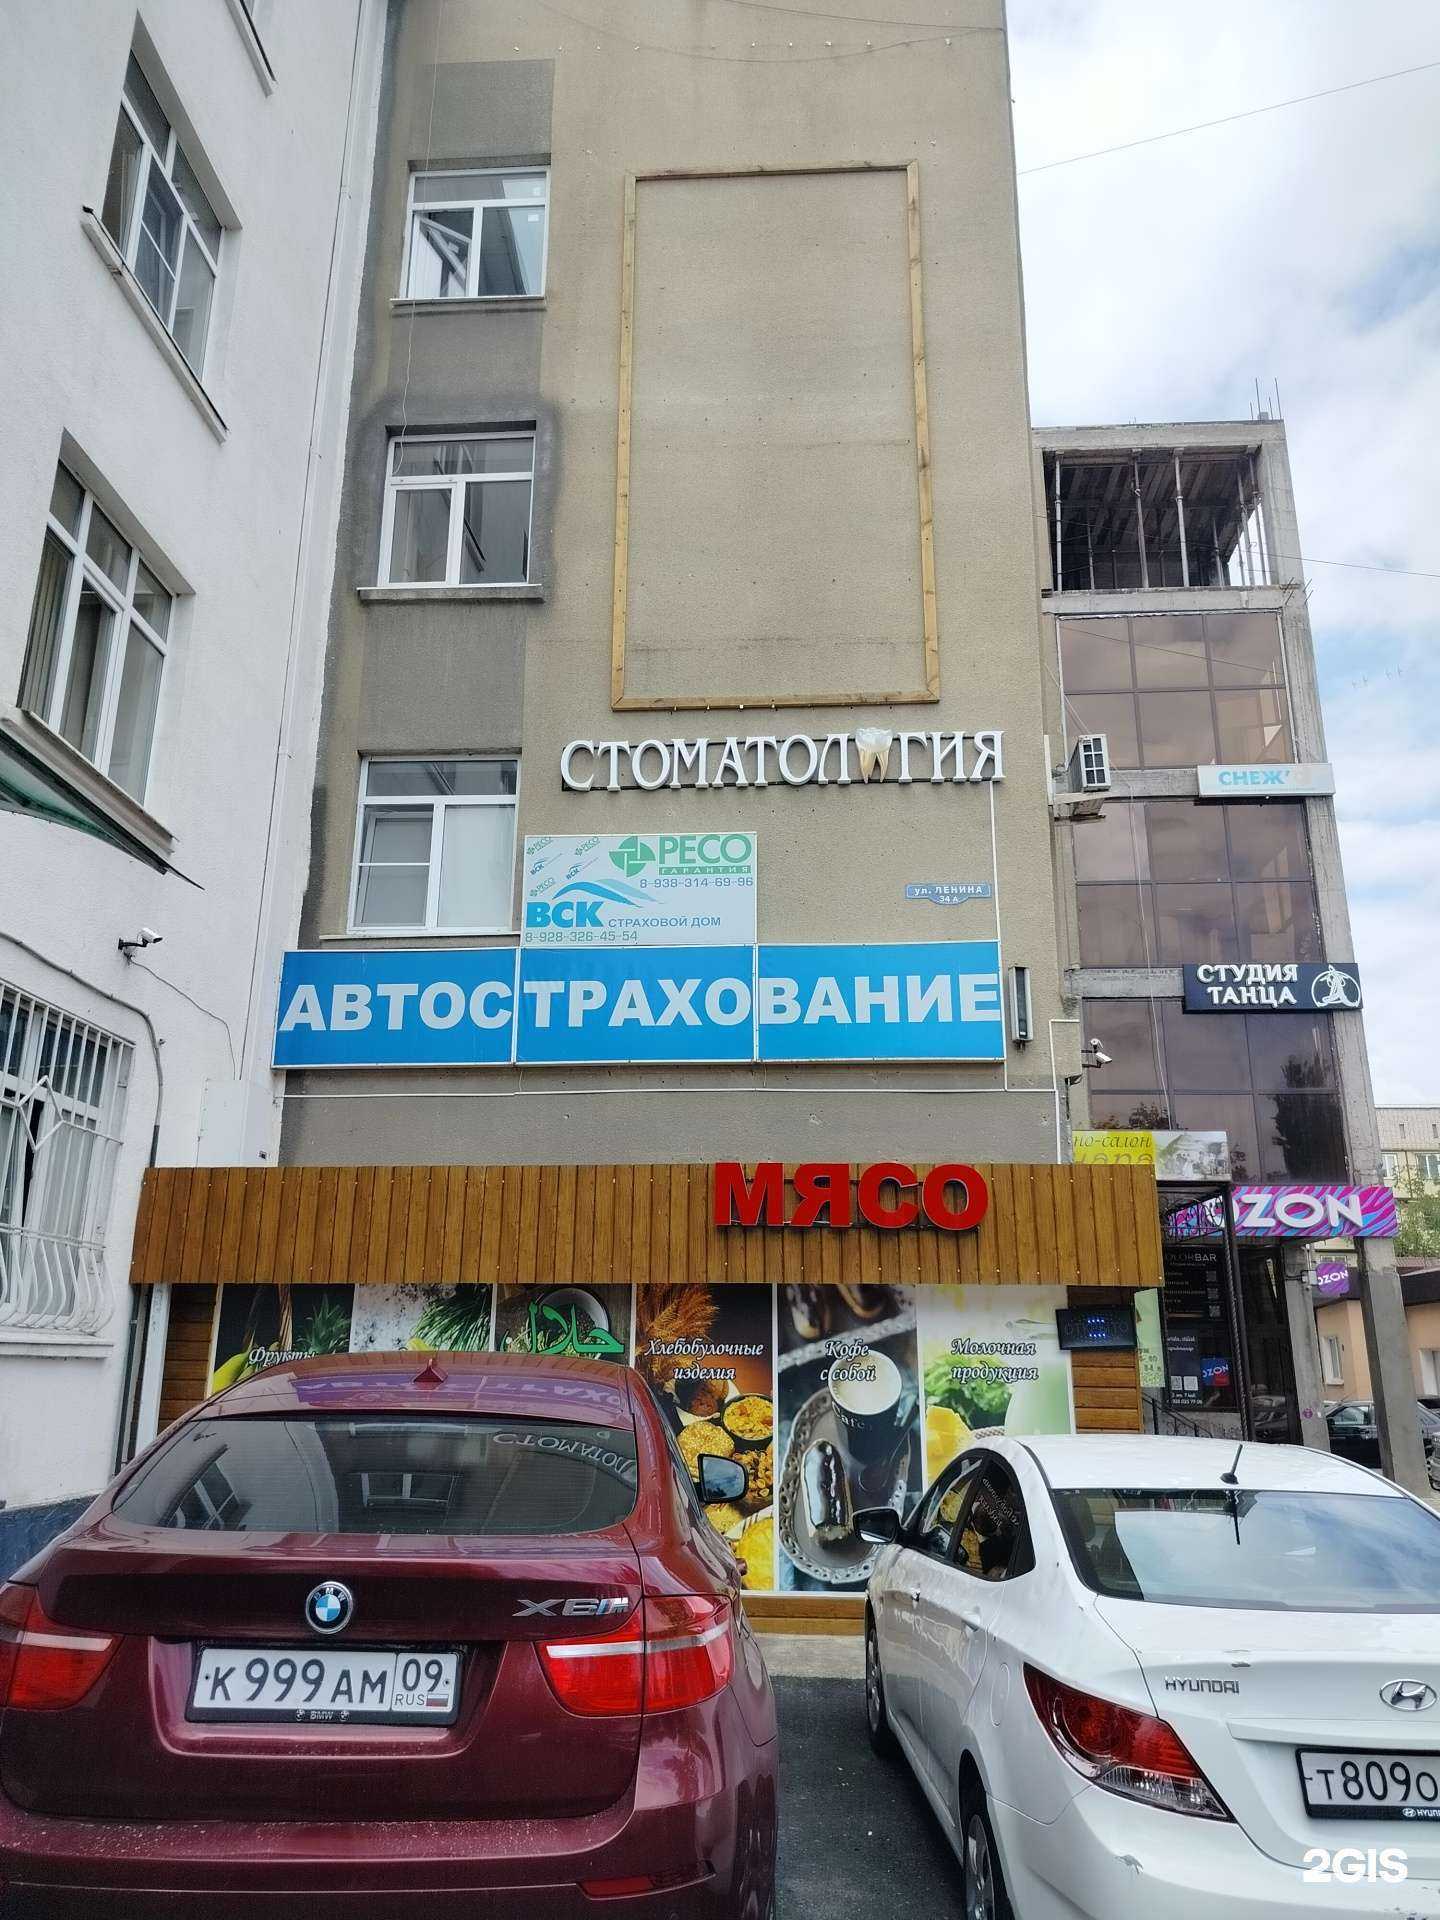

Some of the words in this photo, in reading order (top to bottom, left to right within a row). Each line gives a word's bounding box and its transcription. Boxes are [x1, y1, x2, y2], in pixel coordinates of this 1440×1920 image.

[659, 834, 752, 864] РЕСО
[661, 866, 749, 875] ГАРАНТИЯ
[640, 877, 753, 888] 8-938-314-69-96
[914, 887, 932, 896] ул.
[935, 886, 983, 894] ЛЕНИНА
[526, 902, 604, 928] ВСК
[608, 916, 688, 928] СТРАХОВОЙ
[691, 917, 721, 928] ДОМ
[525, 930, 638, 943] 8-928-326-45-54
[1197, 964, 1299, 985] СТУДИЯ
[279, 973, 1001, 1031] АВТОСТРАХОВАНИЕ
[1206, 986, 1297, 1008] ТАНЦА
[714, 1160, 990, 1231] МЯСО
[645, 1338, 764, 1361] Хлебобулочные
[825, 1338, 869, 1361] Кофе
[951, 1338, 1037, 1355] Молочная
[674, 1362, 736, 1380] изделия
[820, 1368, 828, 1381] с
[832, 1362, 877, 1381] собой
[951, 1360, 1039, 1384] продукция
[402, 1658, 443, 1692] 09
[1165, 1676, 1240, 1694] HYUNDAI
[394, 1693, 425, 1706] RUS
[310, 1711, 333, 1720] BMW
